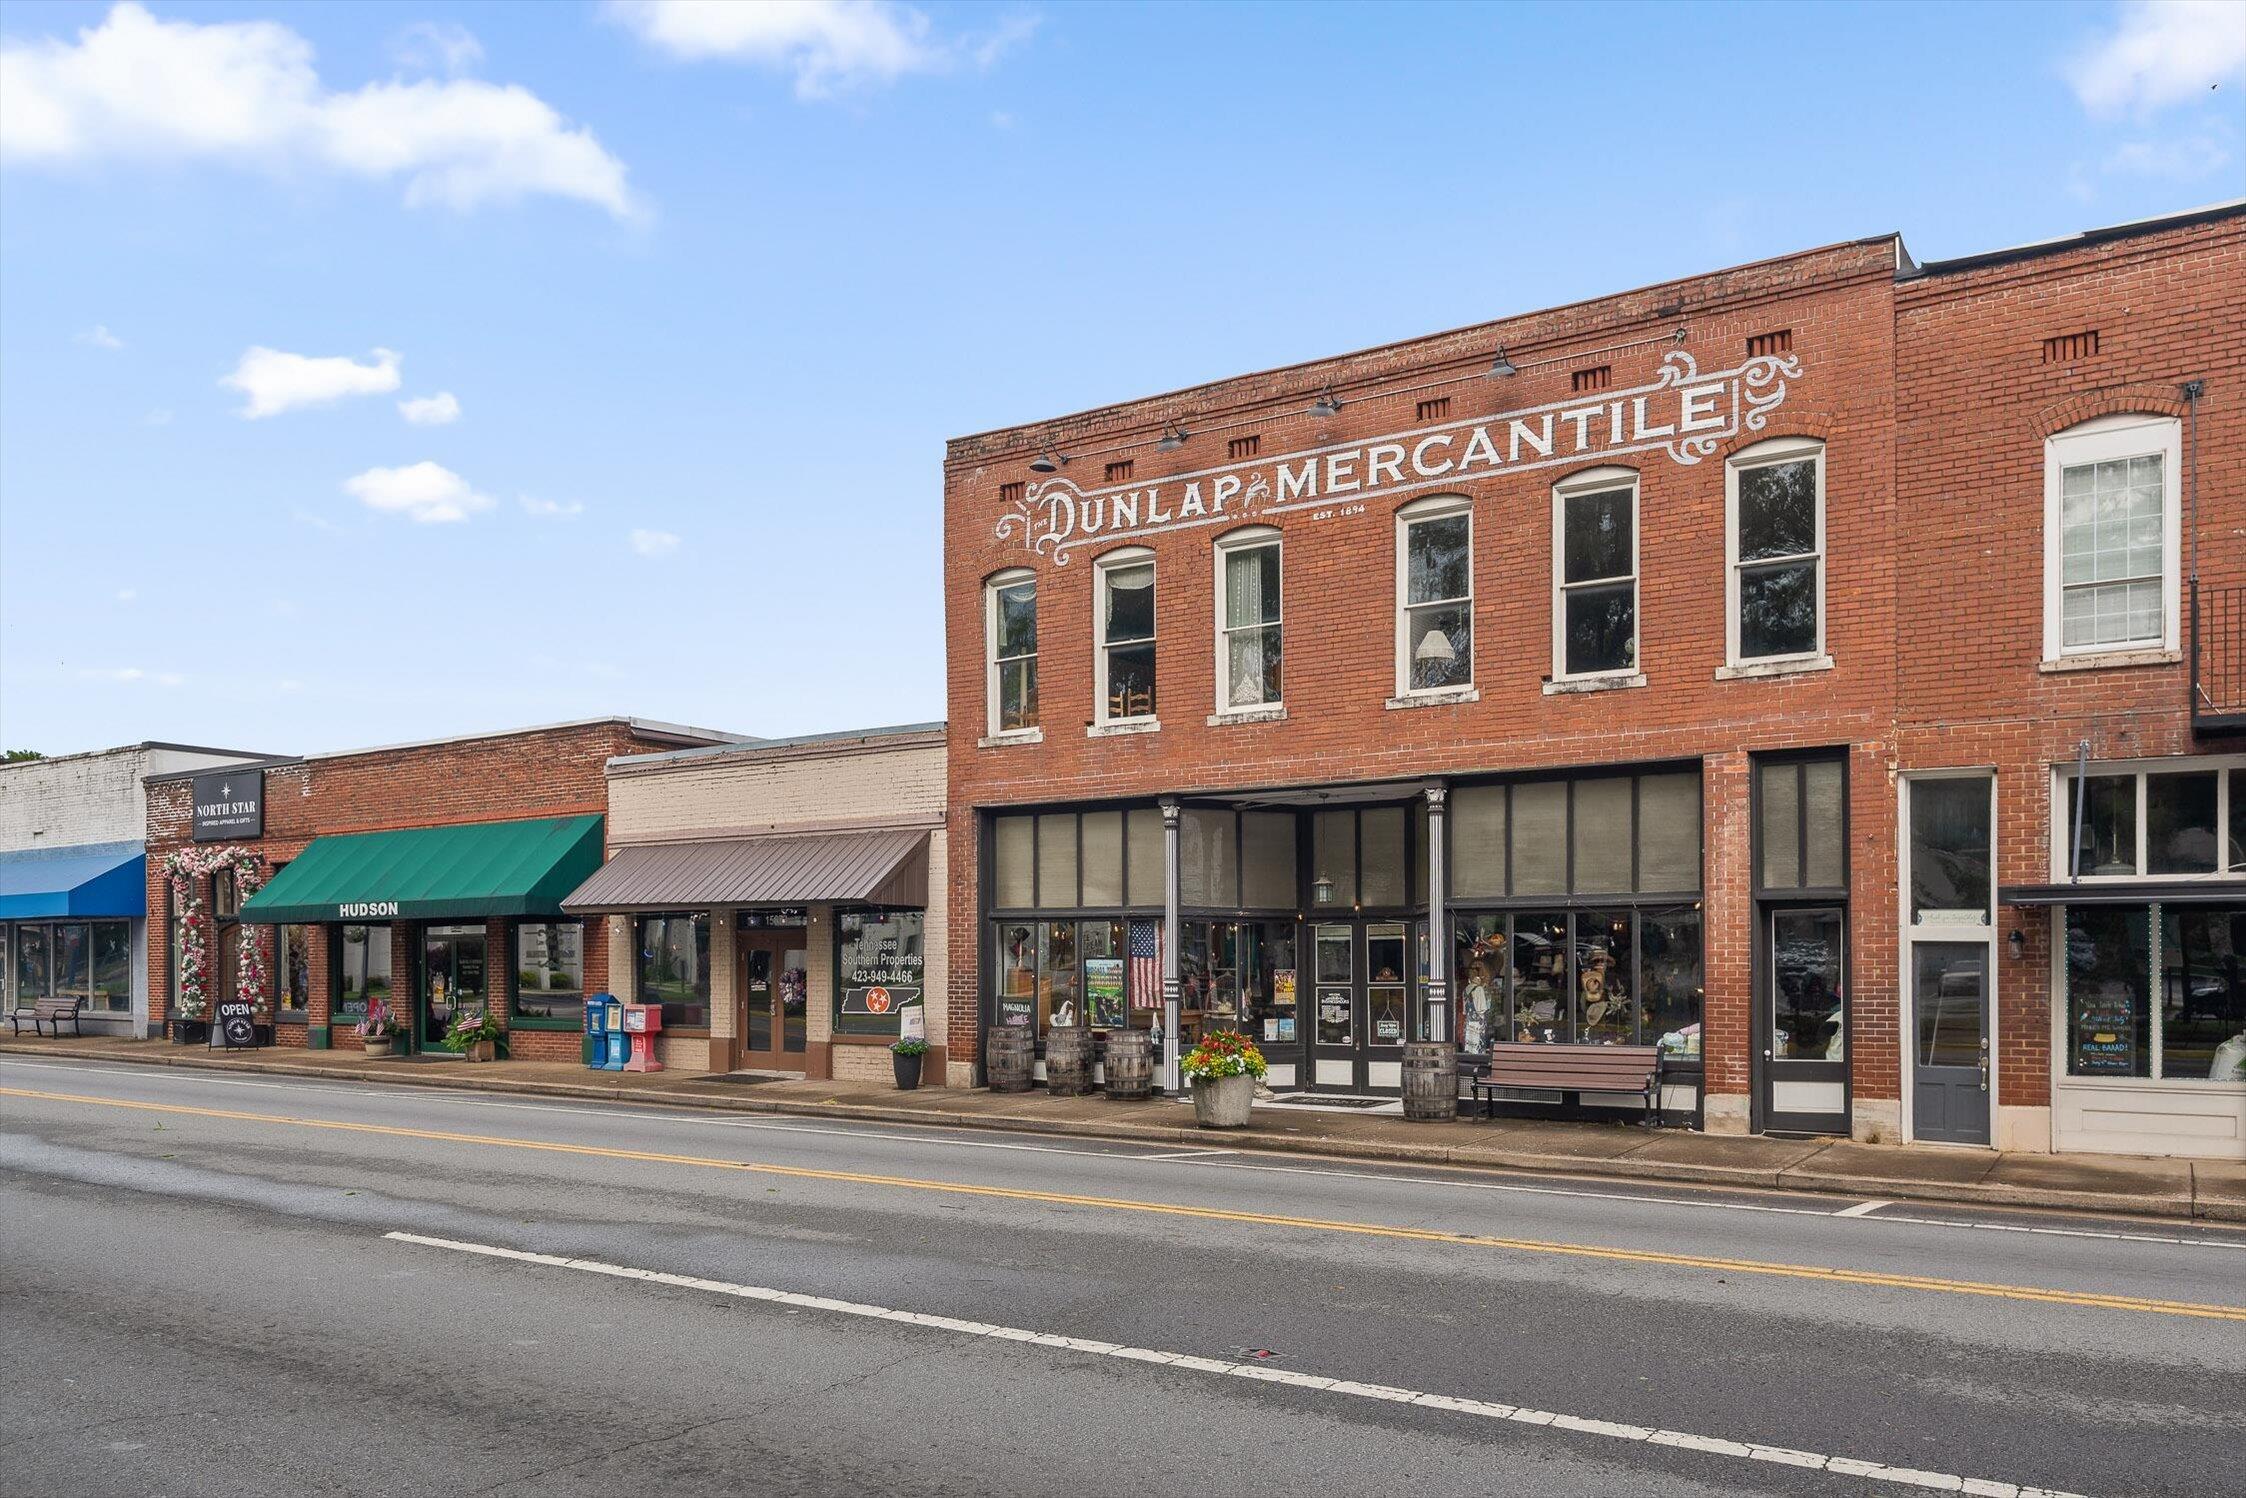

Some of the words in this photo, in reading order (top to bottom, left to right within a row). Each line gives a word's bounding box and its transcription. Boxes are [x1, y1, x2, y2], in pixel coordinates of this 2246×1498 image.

[1275, 382, 1725, 503] MERCANTILE
[1035, 474, 1242, 556] DUNLAP
[1312, 510, 1336, 521] EST.
[1340, 503, 1366, 517] 1894
[1033, 517, 1049, 531] THE
[197, 804, 230, 817] NORTH
[232, 801, 255, 814] STAR
[339, 901, 399, 918] HUDSON
[854, 938, 898, 951] Tennessee
[842, 953, 879, 966] Southern
[880, 952, 923, 969] Properties
[851, 970, 914, 983] 423-949-4466
[221, 1003, 250, 1016] OPEN
